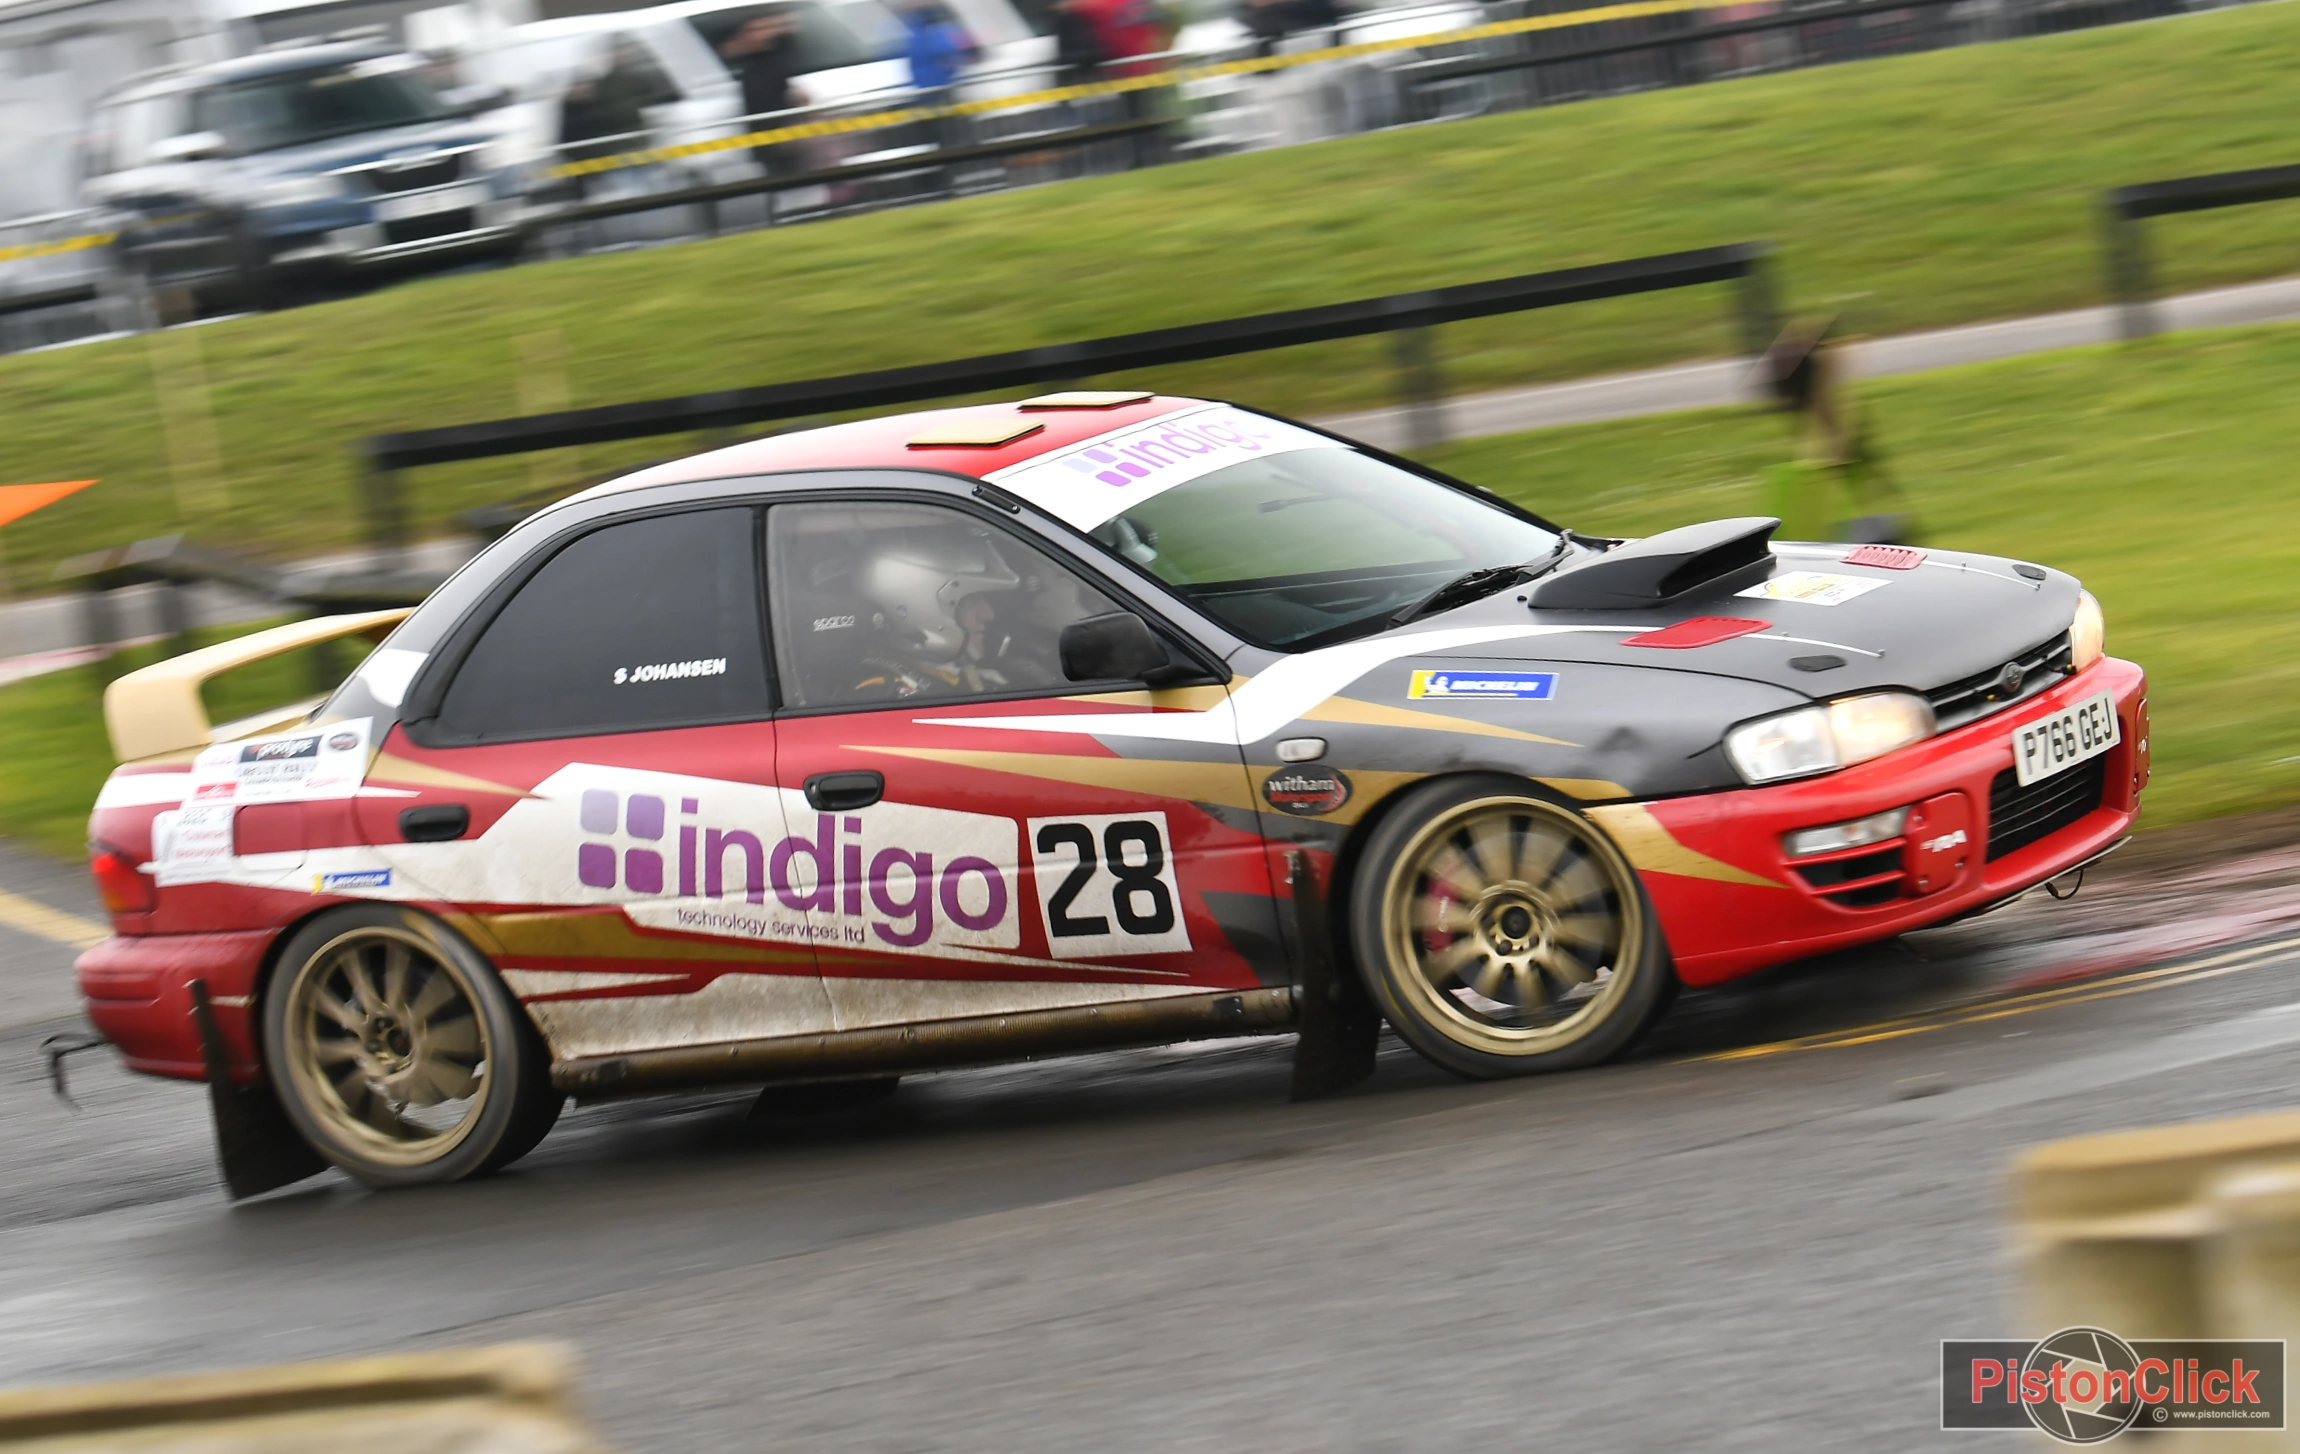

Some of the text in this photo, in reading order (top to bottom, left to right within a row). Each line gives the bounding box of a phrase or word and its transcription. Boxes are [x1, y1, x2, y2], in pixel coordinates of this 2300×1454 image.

[613, 657, 727, 685] S JOHANSEN
[2023, 697, 2113, 776] P766 GEJ
[1268, 775, 1335, 792] witham
[678, 796, 1008, 947] indigo
[1036, 820, 1175, 937] 28
[676, 907, 865, 944] technology services ltd
